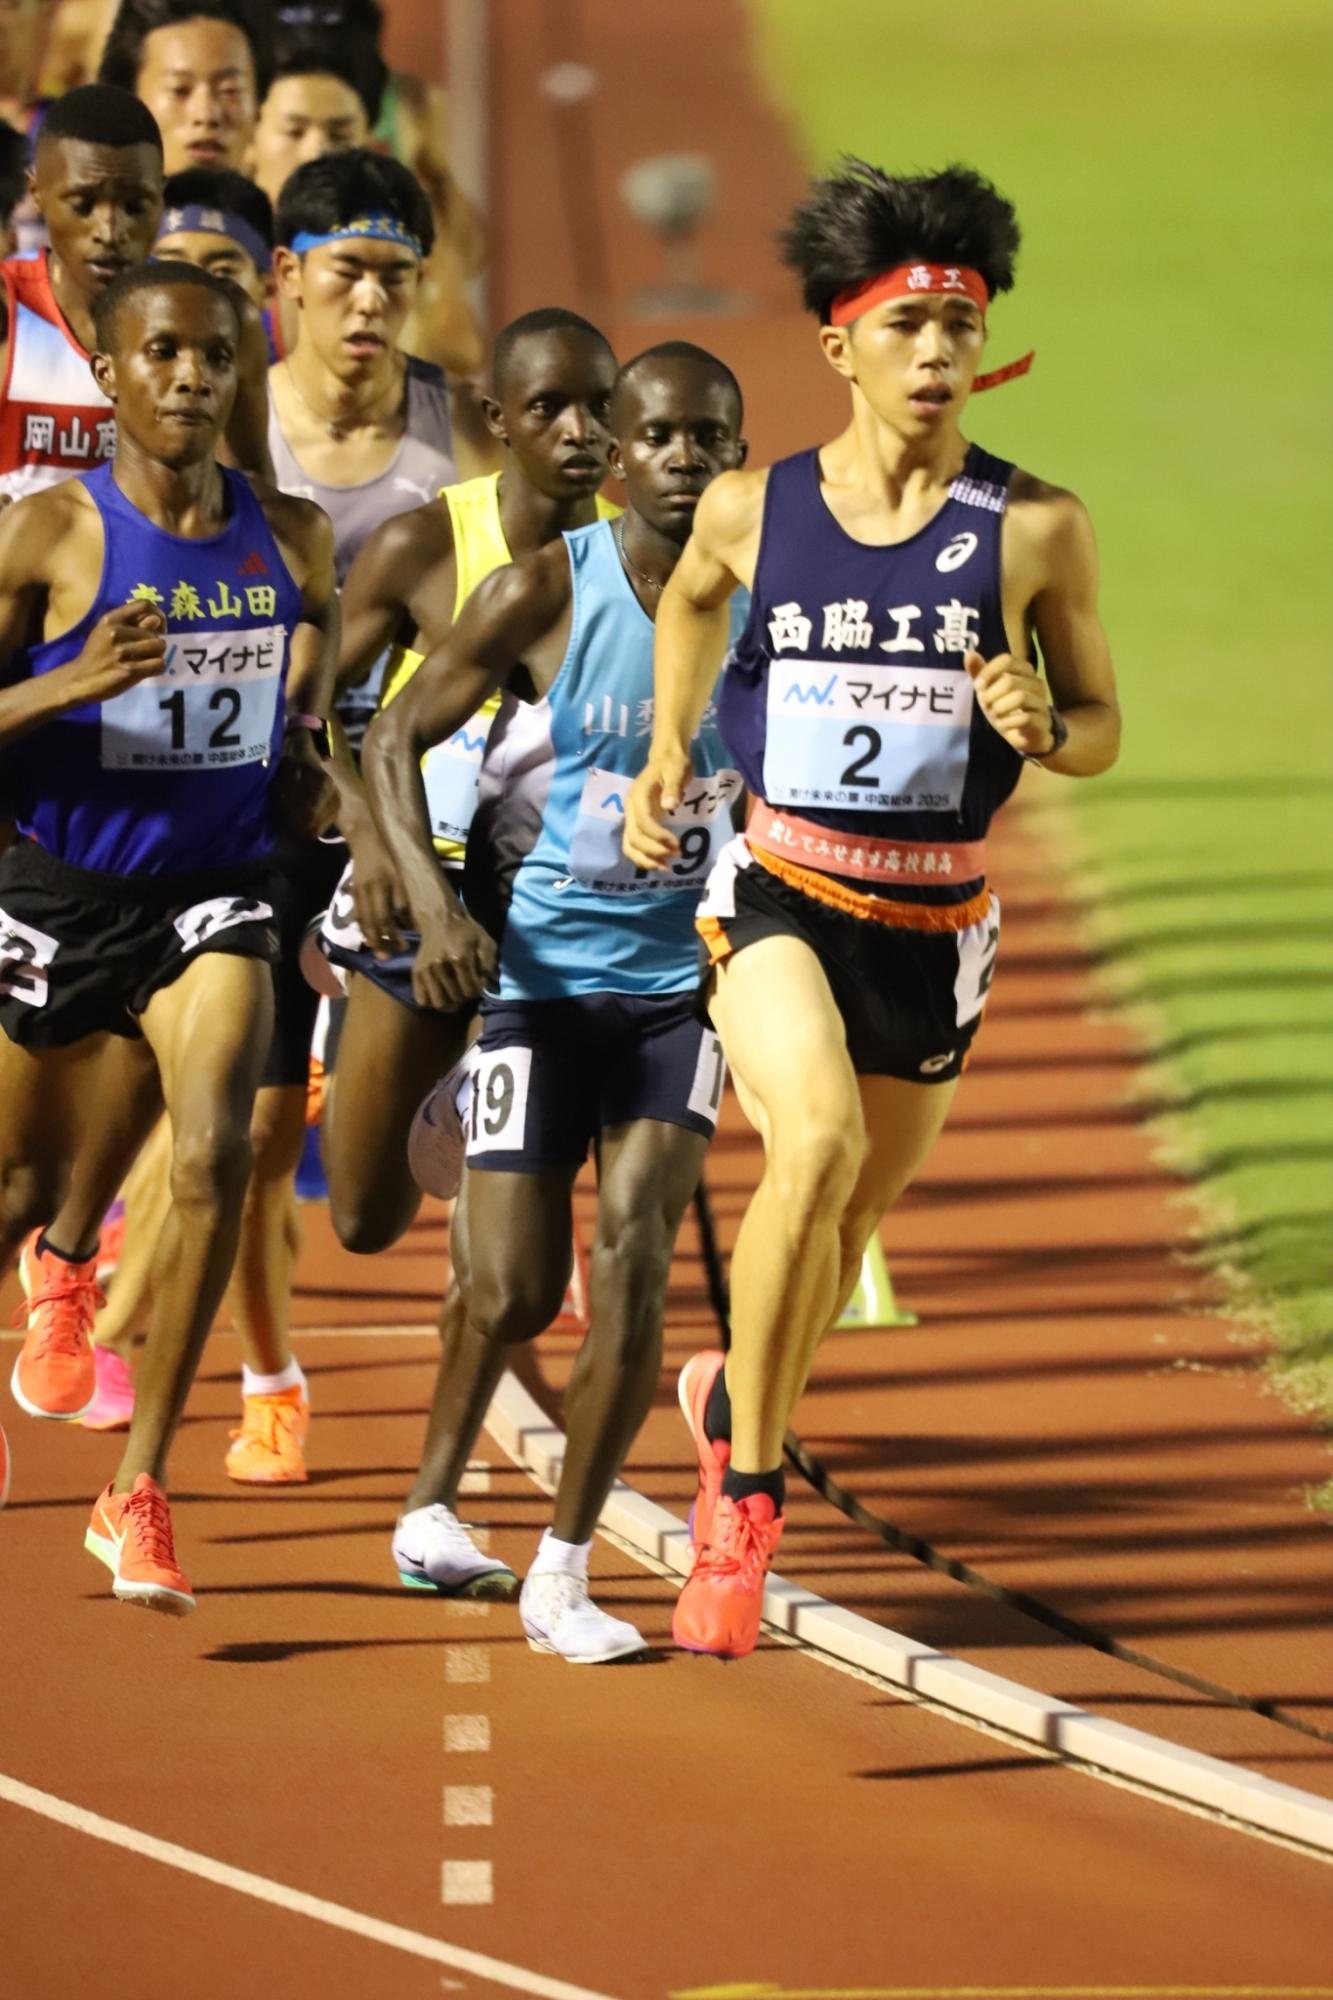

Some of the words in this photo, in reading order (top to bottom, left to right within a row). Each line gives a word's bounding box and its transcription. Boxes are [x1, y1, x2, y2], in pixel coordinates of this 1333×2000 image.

[183, 642, 273, 675] マイナビ
[158, 688, 242, 750] 12
[846, 677, 954, 715] マイナビ
[839, 724, 882, 788] 2
[470, 1062, 515, 1141] 19
